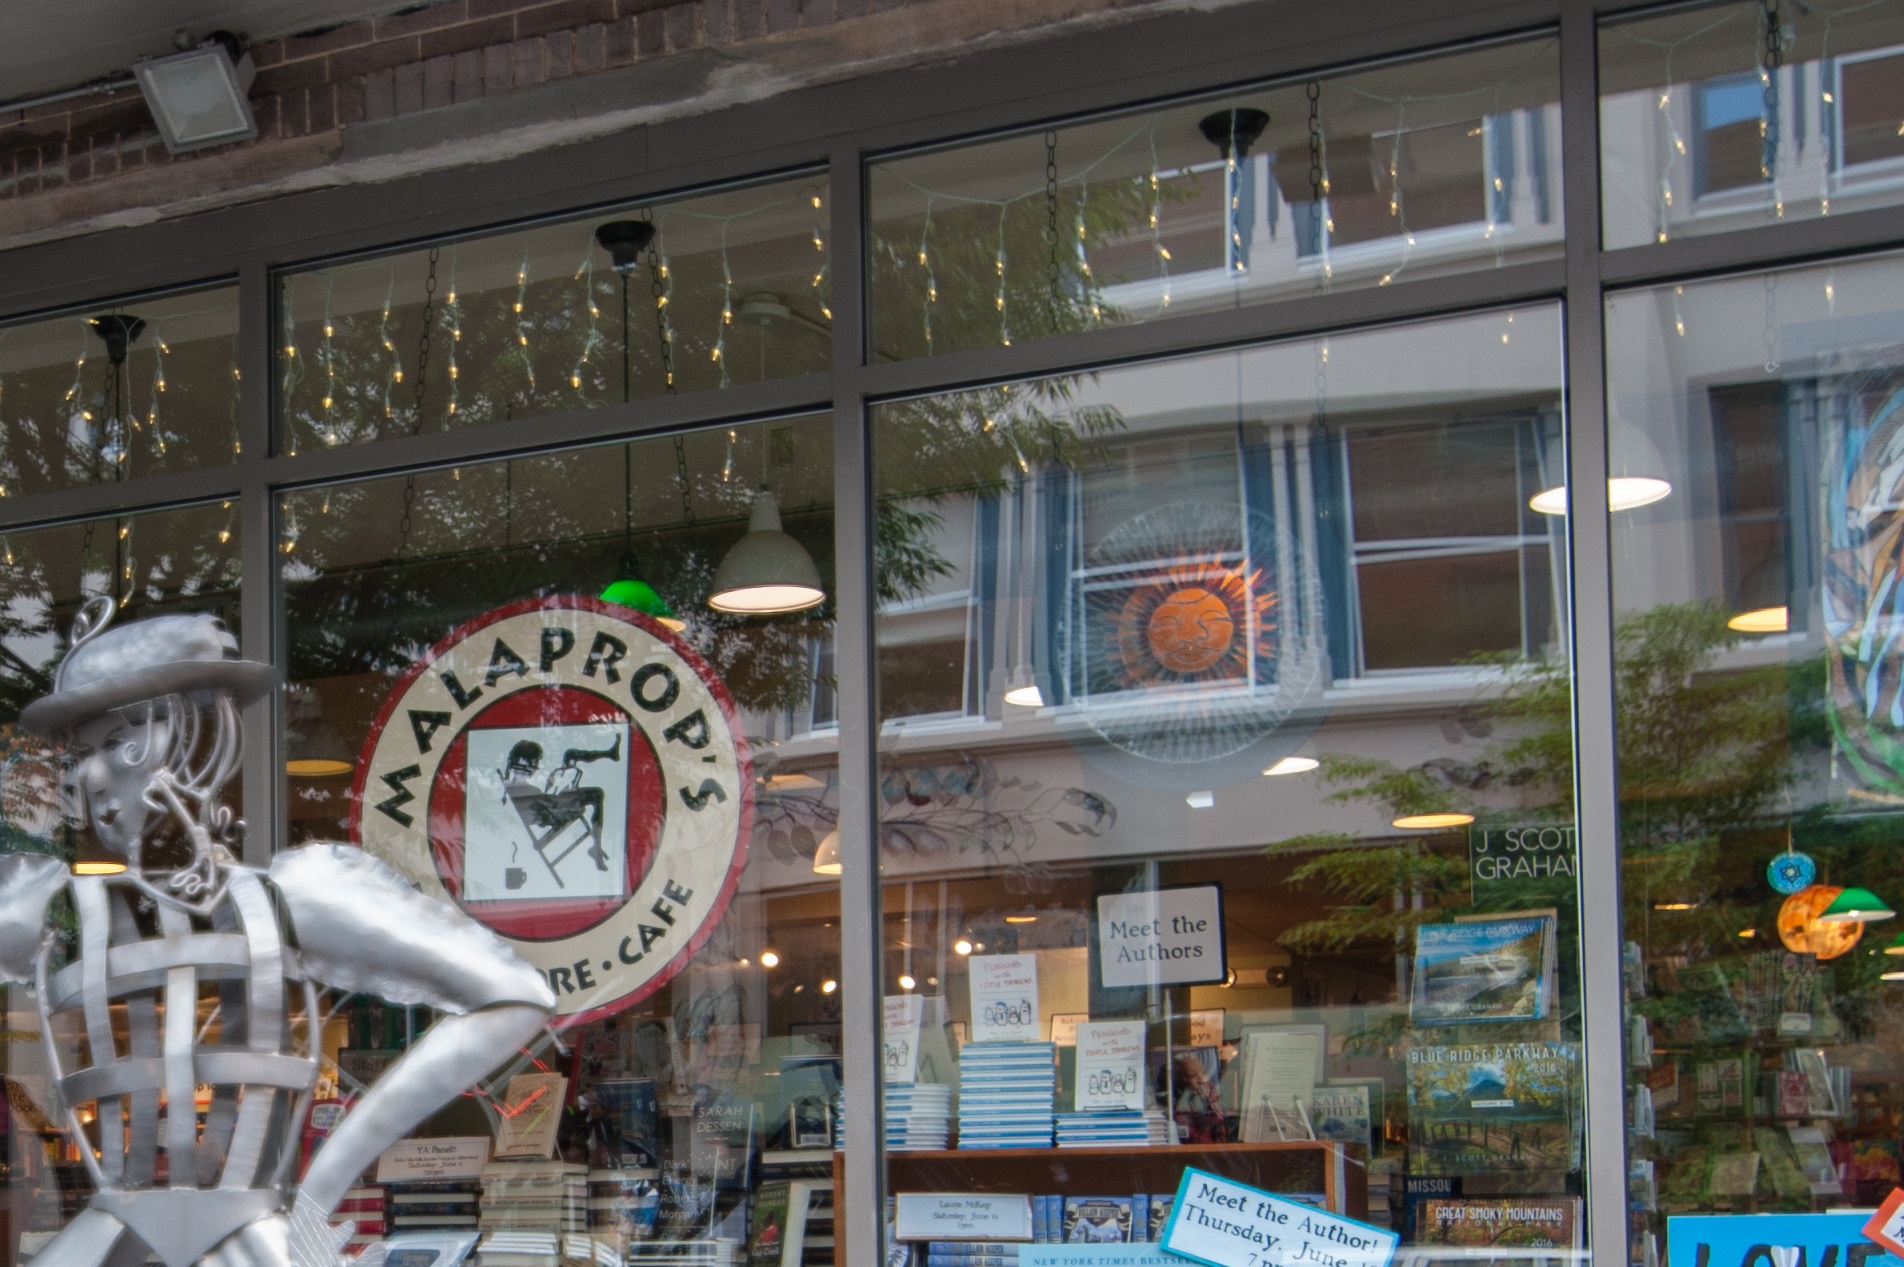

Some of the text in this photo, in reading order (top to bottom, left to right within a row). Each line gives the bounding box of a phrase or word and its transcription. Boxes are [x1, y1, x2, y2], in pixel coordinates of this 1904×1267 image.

[374, 626, 728, 829] MALAPROP'S
[1476, 830, 1488, 853] J
[618, 879, 694, 966] CAFE
[1110, 915, 1208, 939] Meet the
[1117, 942, 1203, 963] Authors
[1411, 1047, 1559, 1064] BLUE RIDGE PARKWAY
[1314, 1095, 1363, 1107] KAREN
[698, 1105, 743, 1118] SARAH
[1313, 1106, 1364, 1116] WHITE
[696, 1121, 741, 1133] DESSEN
[663, 1159, 687, 1170] Dark
[660, 1193, 695, 1204] Robert
[658, 1209, 696, 1222] Morgan
[969, 1212, 989, 1221] June
[1197, 1183, 1378, 1254] Meet the Author!
[1435, 1206, 1563, 1221] GREAT SMOKY MOUNTAINS
[1530, 1238, 1553, 1248] 2016
[1033, 1257, 1136, 1266] NEW YORK TIMES
[1247, 1252, 1258, 1267] 7
